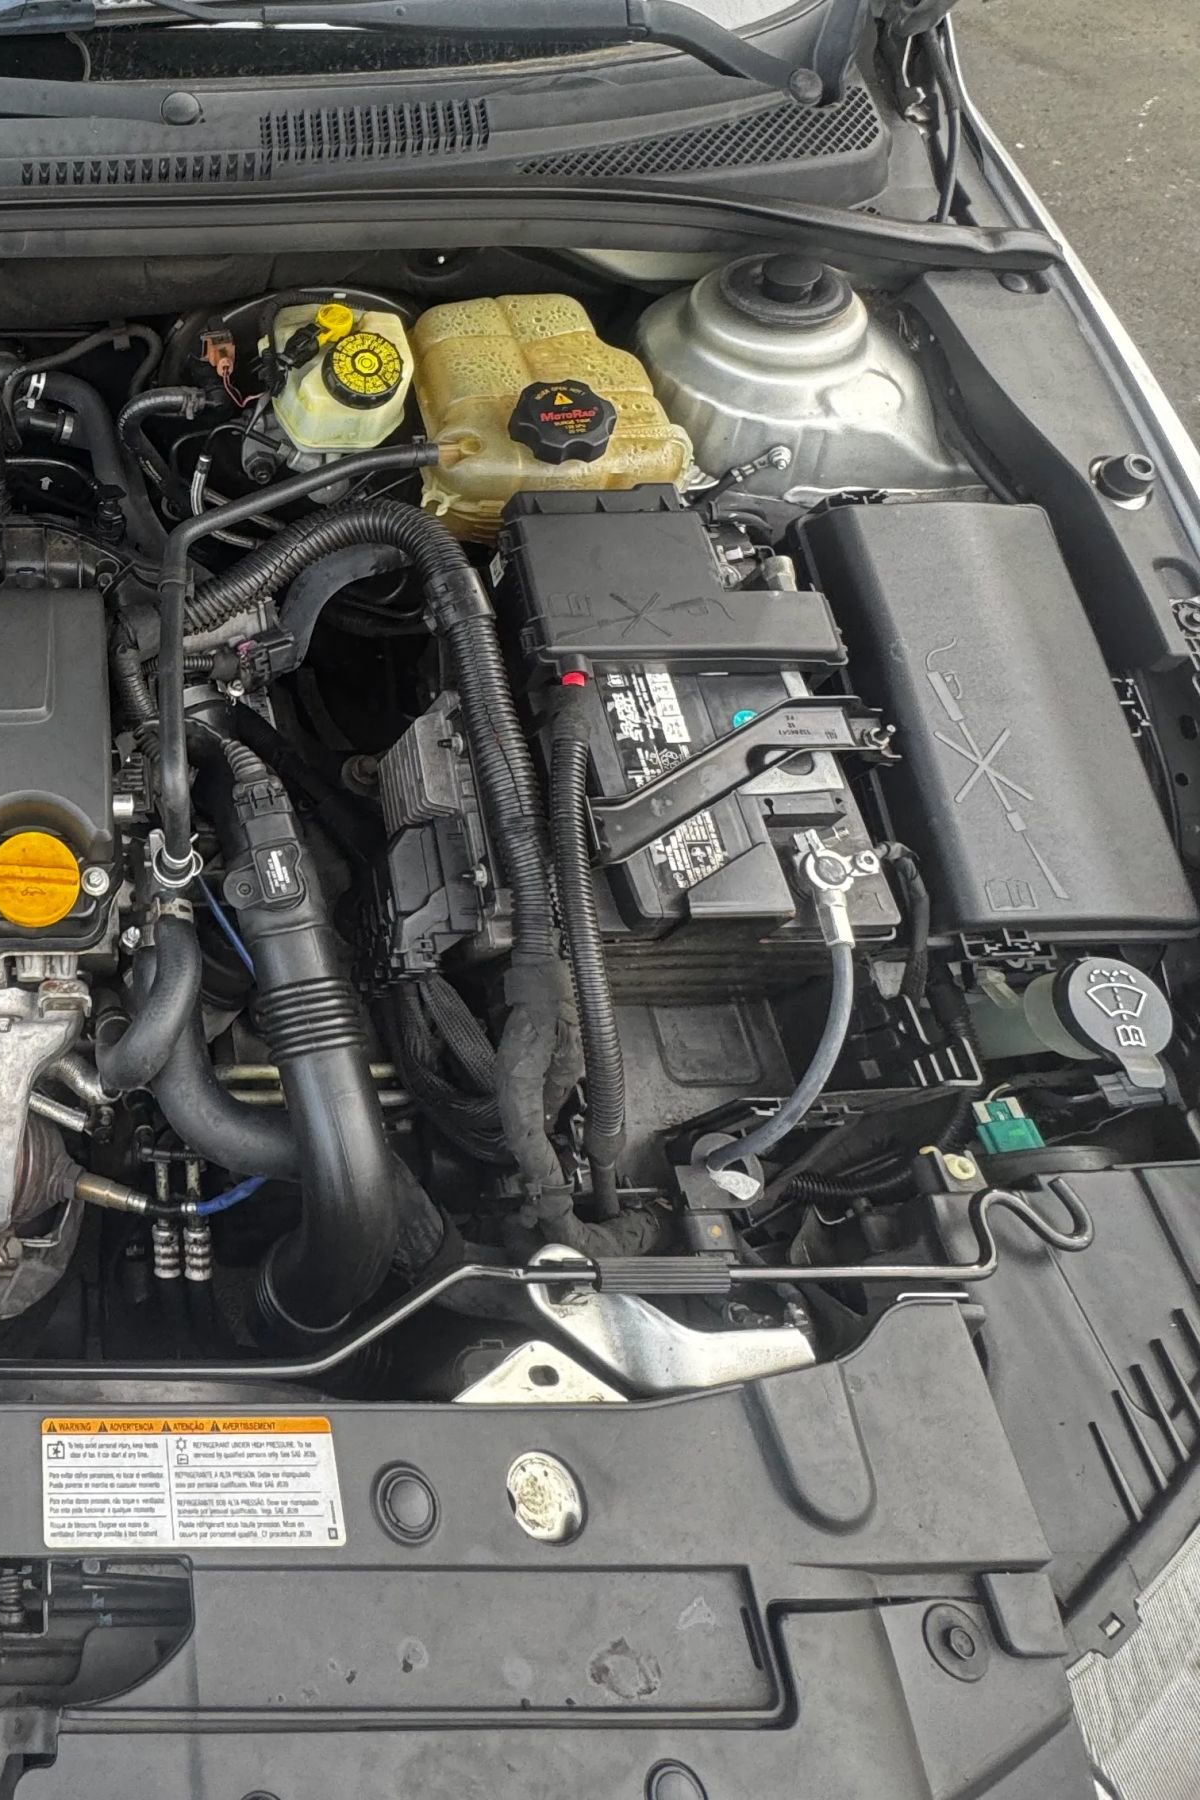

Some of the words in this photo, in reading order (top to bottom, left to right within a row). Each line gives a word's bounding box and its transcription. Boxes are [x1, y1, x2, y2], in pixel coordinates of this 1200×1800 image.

[110, 1423, 154, 1431] ADVERTENCIA
[173, 1421, 204, 1432] ATENÇÃO
[222, 1422, 276, 1430] AVERTISSEMENT
